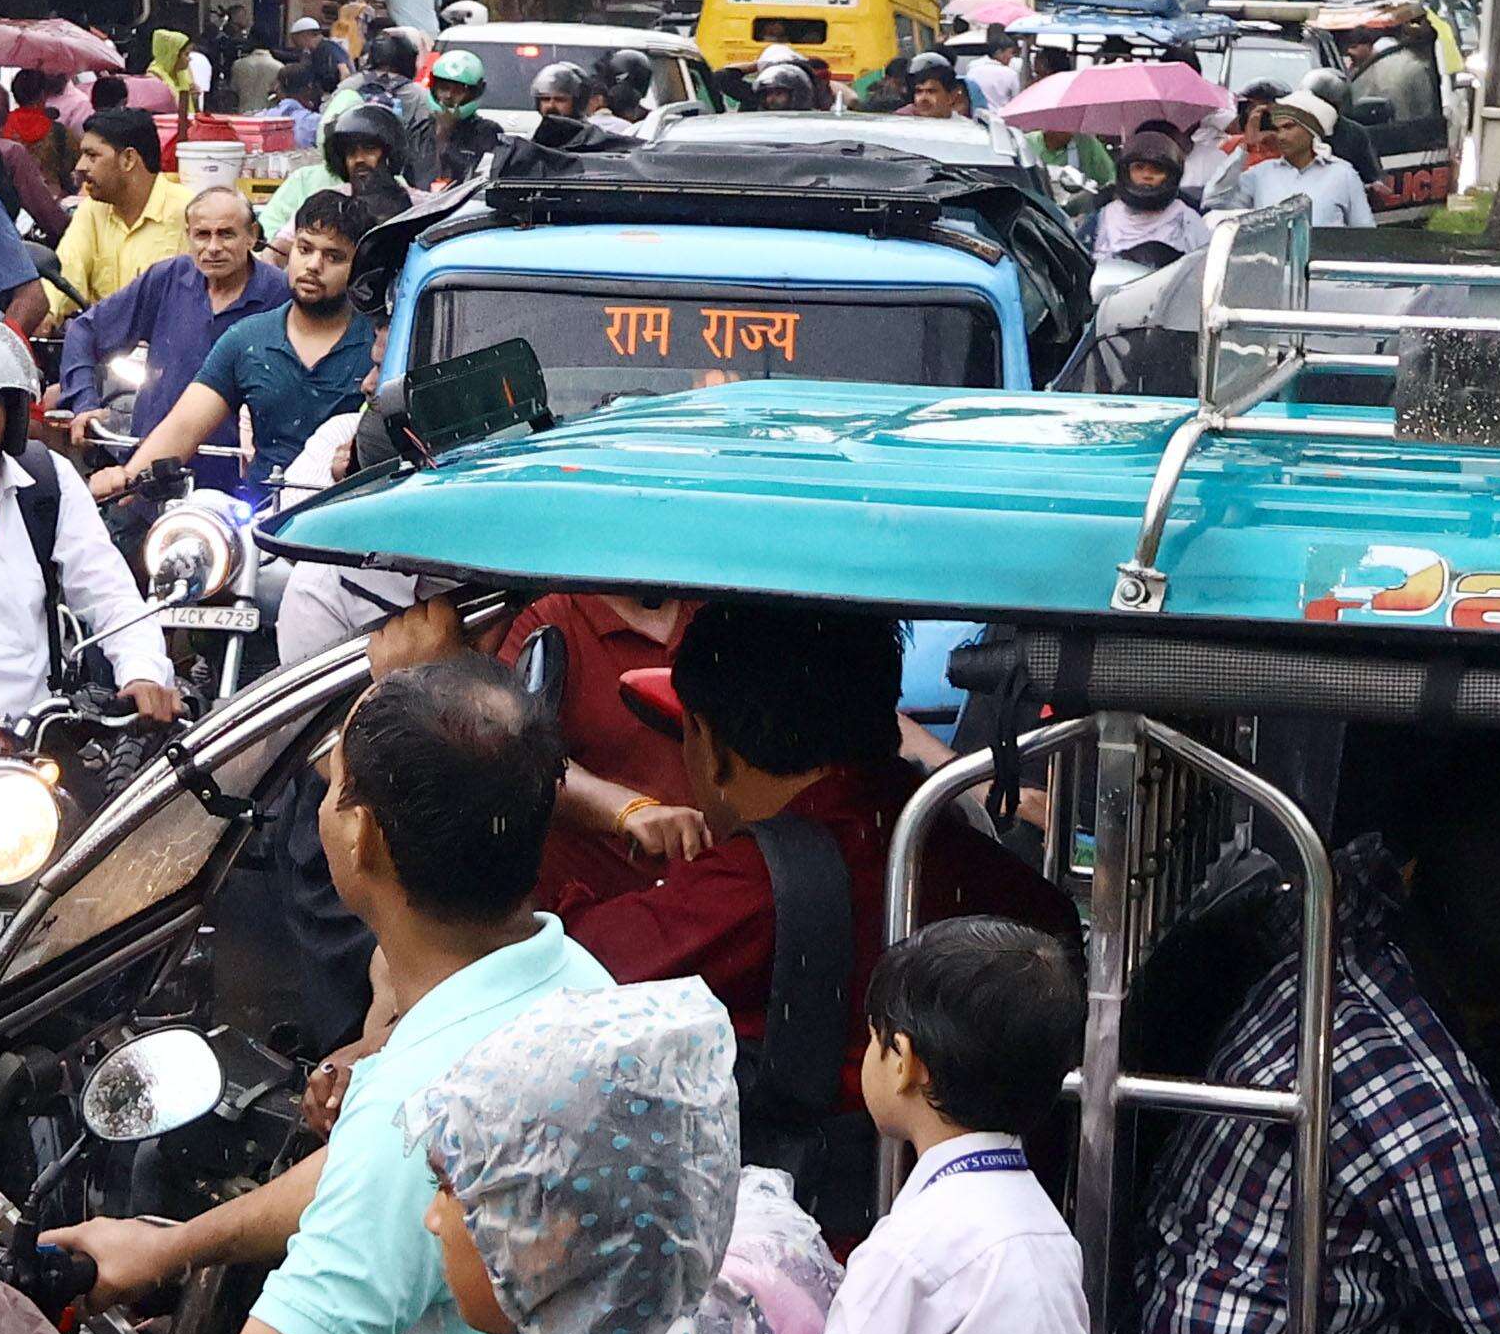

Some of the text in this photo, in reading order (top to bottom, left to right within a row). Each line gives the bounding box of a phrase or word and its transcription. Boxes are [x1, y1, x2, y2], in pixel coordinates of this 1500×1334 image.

[1385, 167, 1450, 208] LICE
[604, 306, 800, 361] राम राज्य
[214, 611, 255, 628] 4725
[935, 1156, 980, 1181] MARY'S
